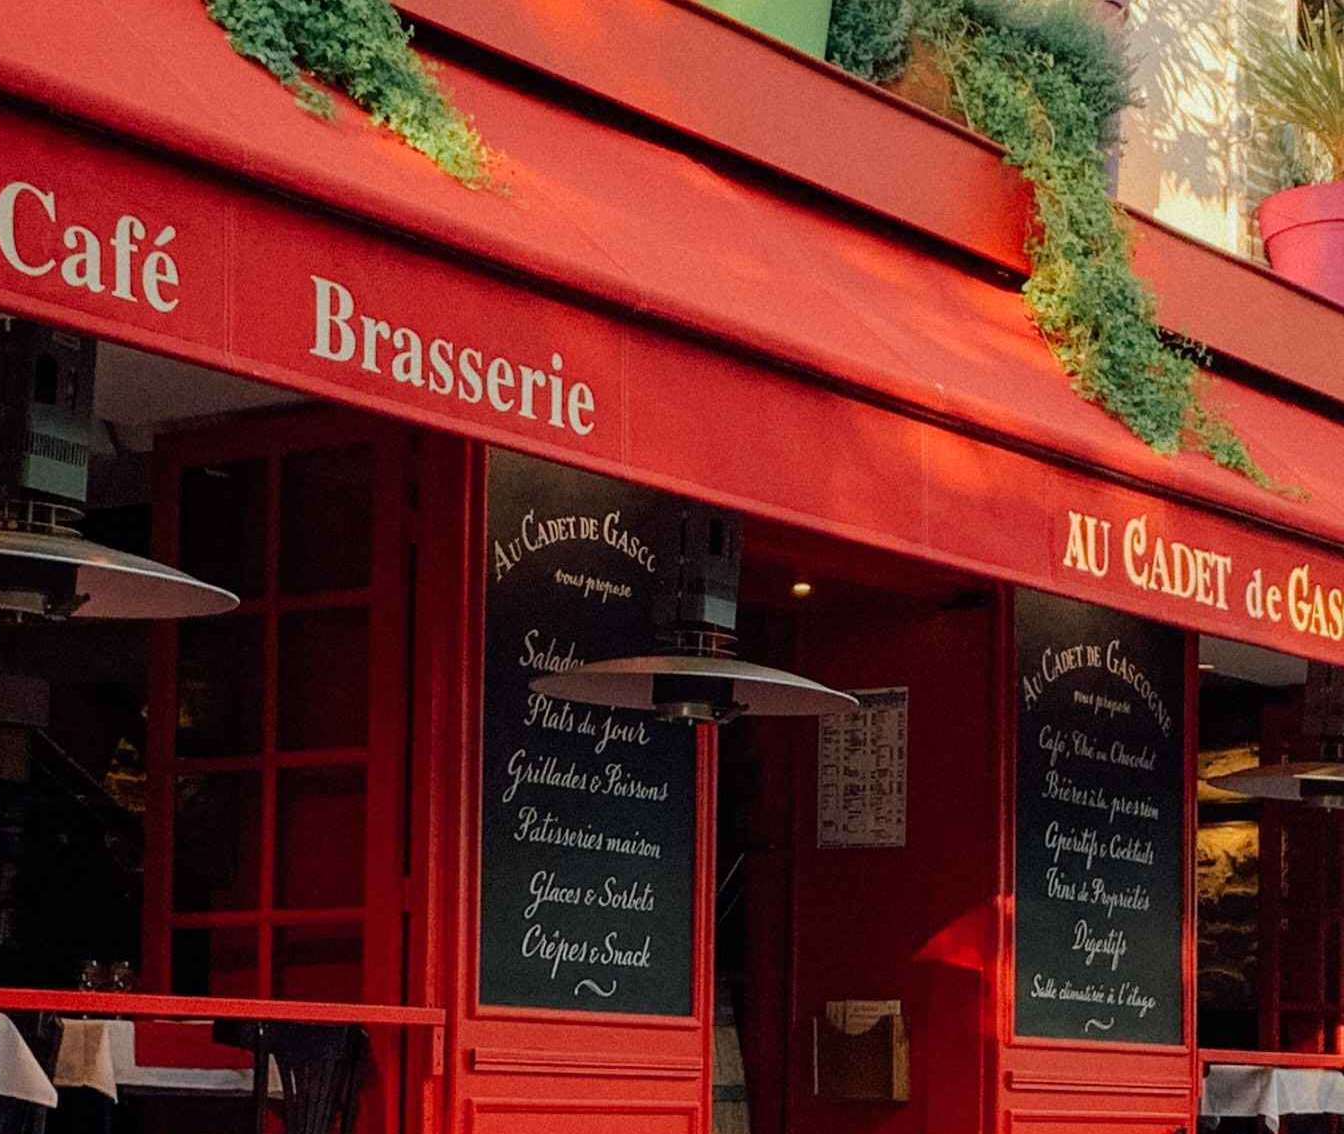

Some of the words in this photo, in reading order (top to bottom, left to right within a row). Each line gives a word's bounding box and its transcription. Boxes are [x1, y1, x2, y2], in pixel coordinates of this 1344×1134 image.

[309, 274, 596, 437] Brasserie
[521, 509, 578, 552] CADET
[579, 516, 600, 542] DE
[555, 568, 585, 588] vous
[584, 574, 633, 603] propose
[1063, 510, 1111, 578] AU
[1122, 513, 1233, 611] CADET
[1244, 568, 1282, 623] de
[1086, 645, 1102, 668] DE
[523, 692, 574, 733] Plats
[577, 711, 597, 735] du
[502, 749, 587, 803] Grillades
[589, 775, 602, 794] &
[601, 763, 669, 801] Poissons
[1041, 770, 1088, 808] Bières
[1109, 796, 1159, 824] pression
[606, 831, 662, 860] maison
[1044, 820, 1099, 871] Apéritifs
[1109, 834, 1154, 866] Cocktails
[523, 870, 581, 920] Glaces
[584, 888, 596, 906] &
[598, 876, 655, 912] Sorbets
[1046, 866, 1077, 901] Vins
[1077, 882, 1090, 903] de
[1090, 877, 1151, 919] Propriétés
[521, 924, 588, 980] Crêpes
[589, 946, 600, 964] &
[601, 931, 651, 968] Snack
[1071, 919, 1127, 972] Digestifs
[1030, 973, 1057, 1000] Salle
[1058, 979, 1106, 1004] climatisée
[1106, 988, 1116, 1005] à
[1117, 981, 1157, 1019] l'étage
